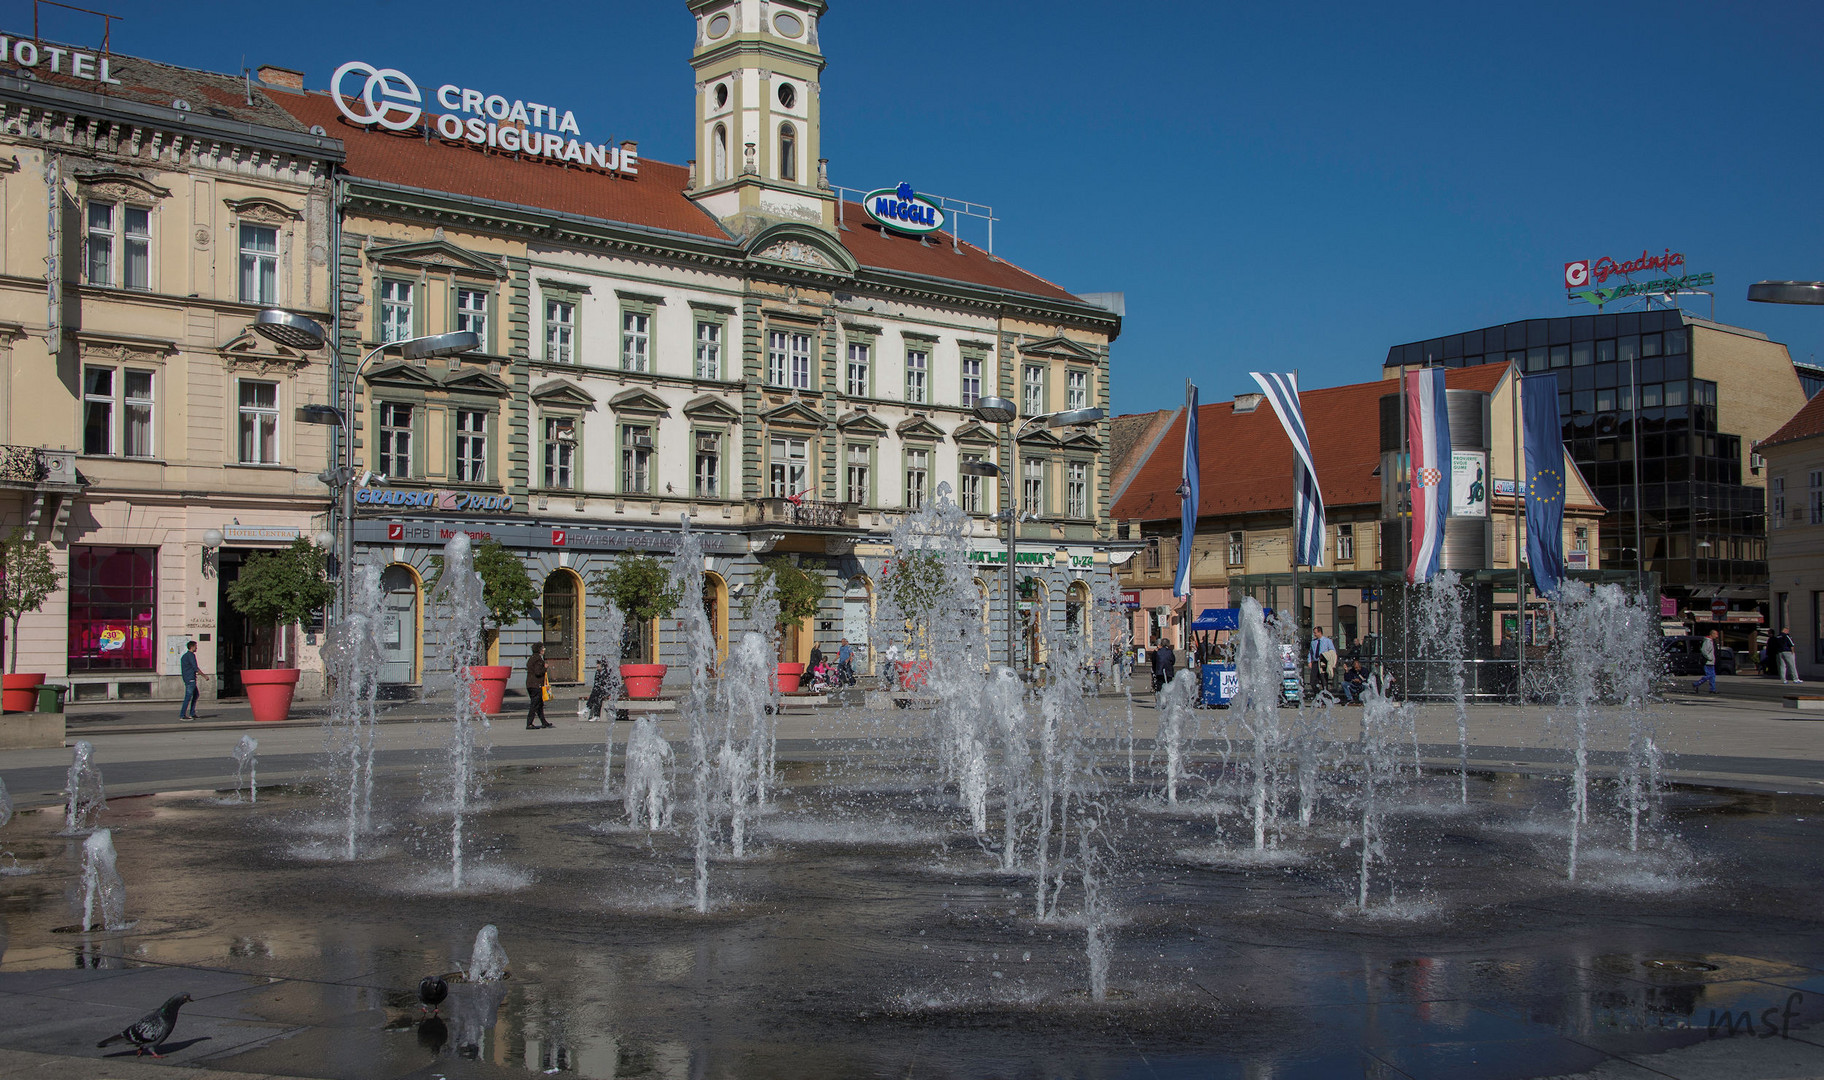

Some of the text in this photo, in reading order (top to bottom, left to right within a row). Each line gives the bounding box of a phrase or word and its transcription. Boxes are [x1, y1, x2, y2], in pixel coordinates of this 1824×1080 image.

[437, 84, 581, 136] CROATIA
[437, 113, 638, 175] OSIGURANJE
[875, 197, 935, 226] MEGGLE
[49, 163, 58, 328] CENTRAL
[1593, 248, 1685, 283] Gradnja
[356, 489, 512, 511] GRADSKI RADIO
[405, 528, 430, 539] HPB
[567, 534, 622, 546] HRVATSKA
[988, 551, 1045, 564] LJEARNA
[1072, 555, 1094, 567] 0-24
[1222, 675, 1239, 685] JW
